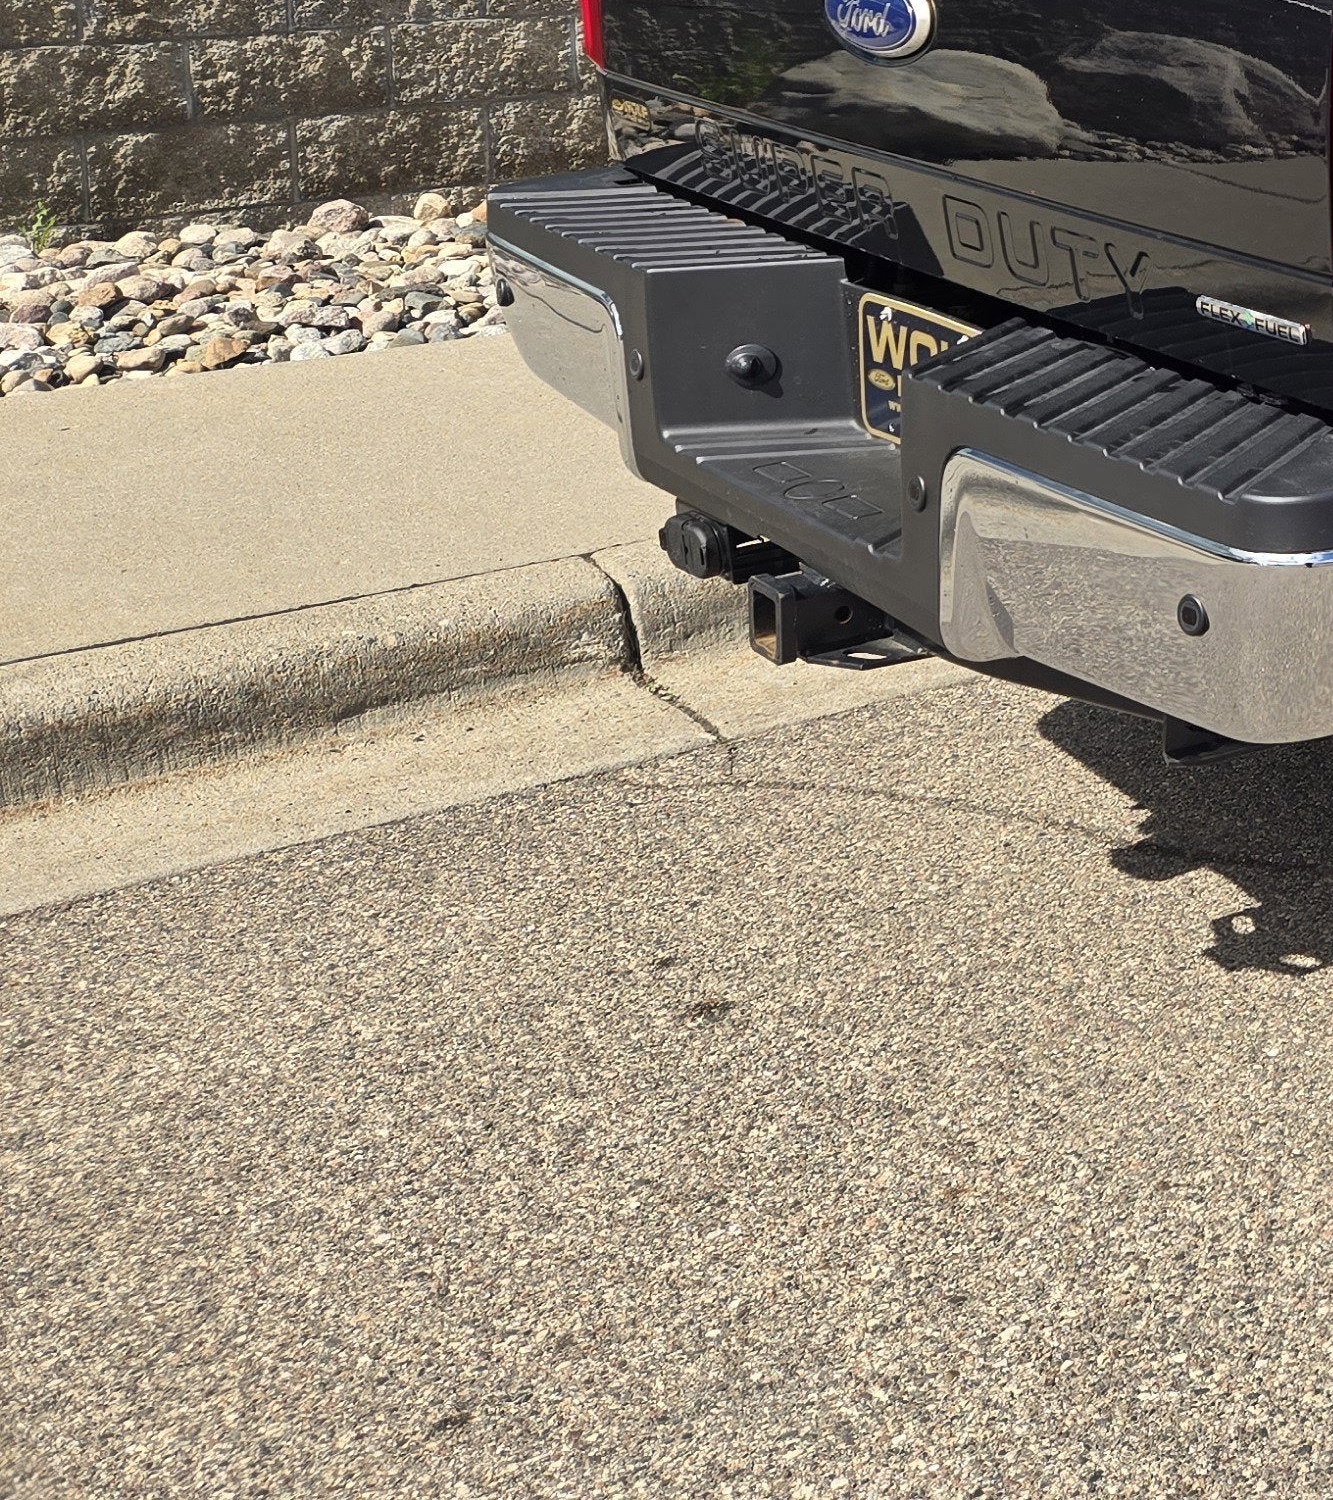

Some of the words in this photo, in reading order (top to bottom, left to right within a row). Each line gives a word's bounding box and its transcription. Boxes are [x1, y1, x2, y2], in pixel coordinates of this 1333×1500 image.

[695, 117, 899, 240] SUPER
[943, 194, 1150, 320] DUTY
[866, 315, 949, 370] WO
[1200, 301, 1242, 326] FLEX
[1255, 317, 1301, 342] FUEL
